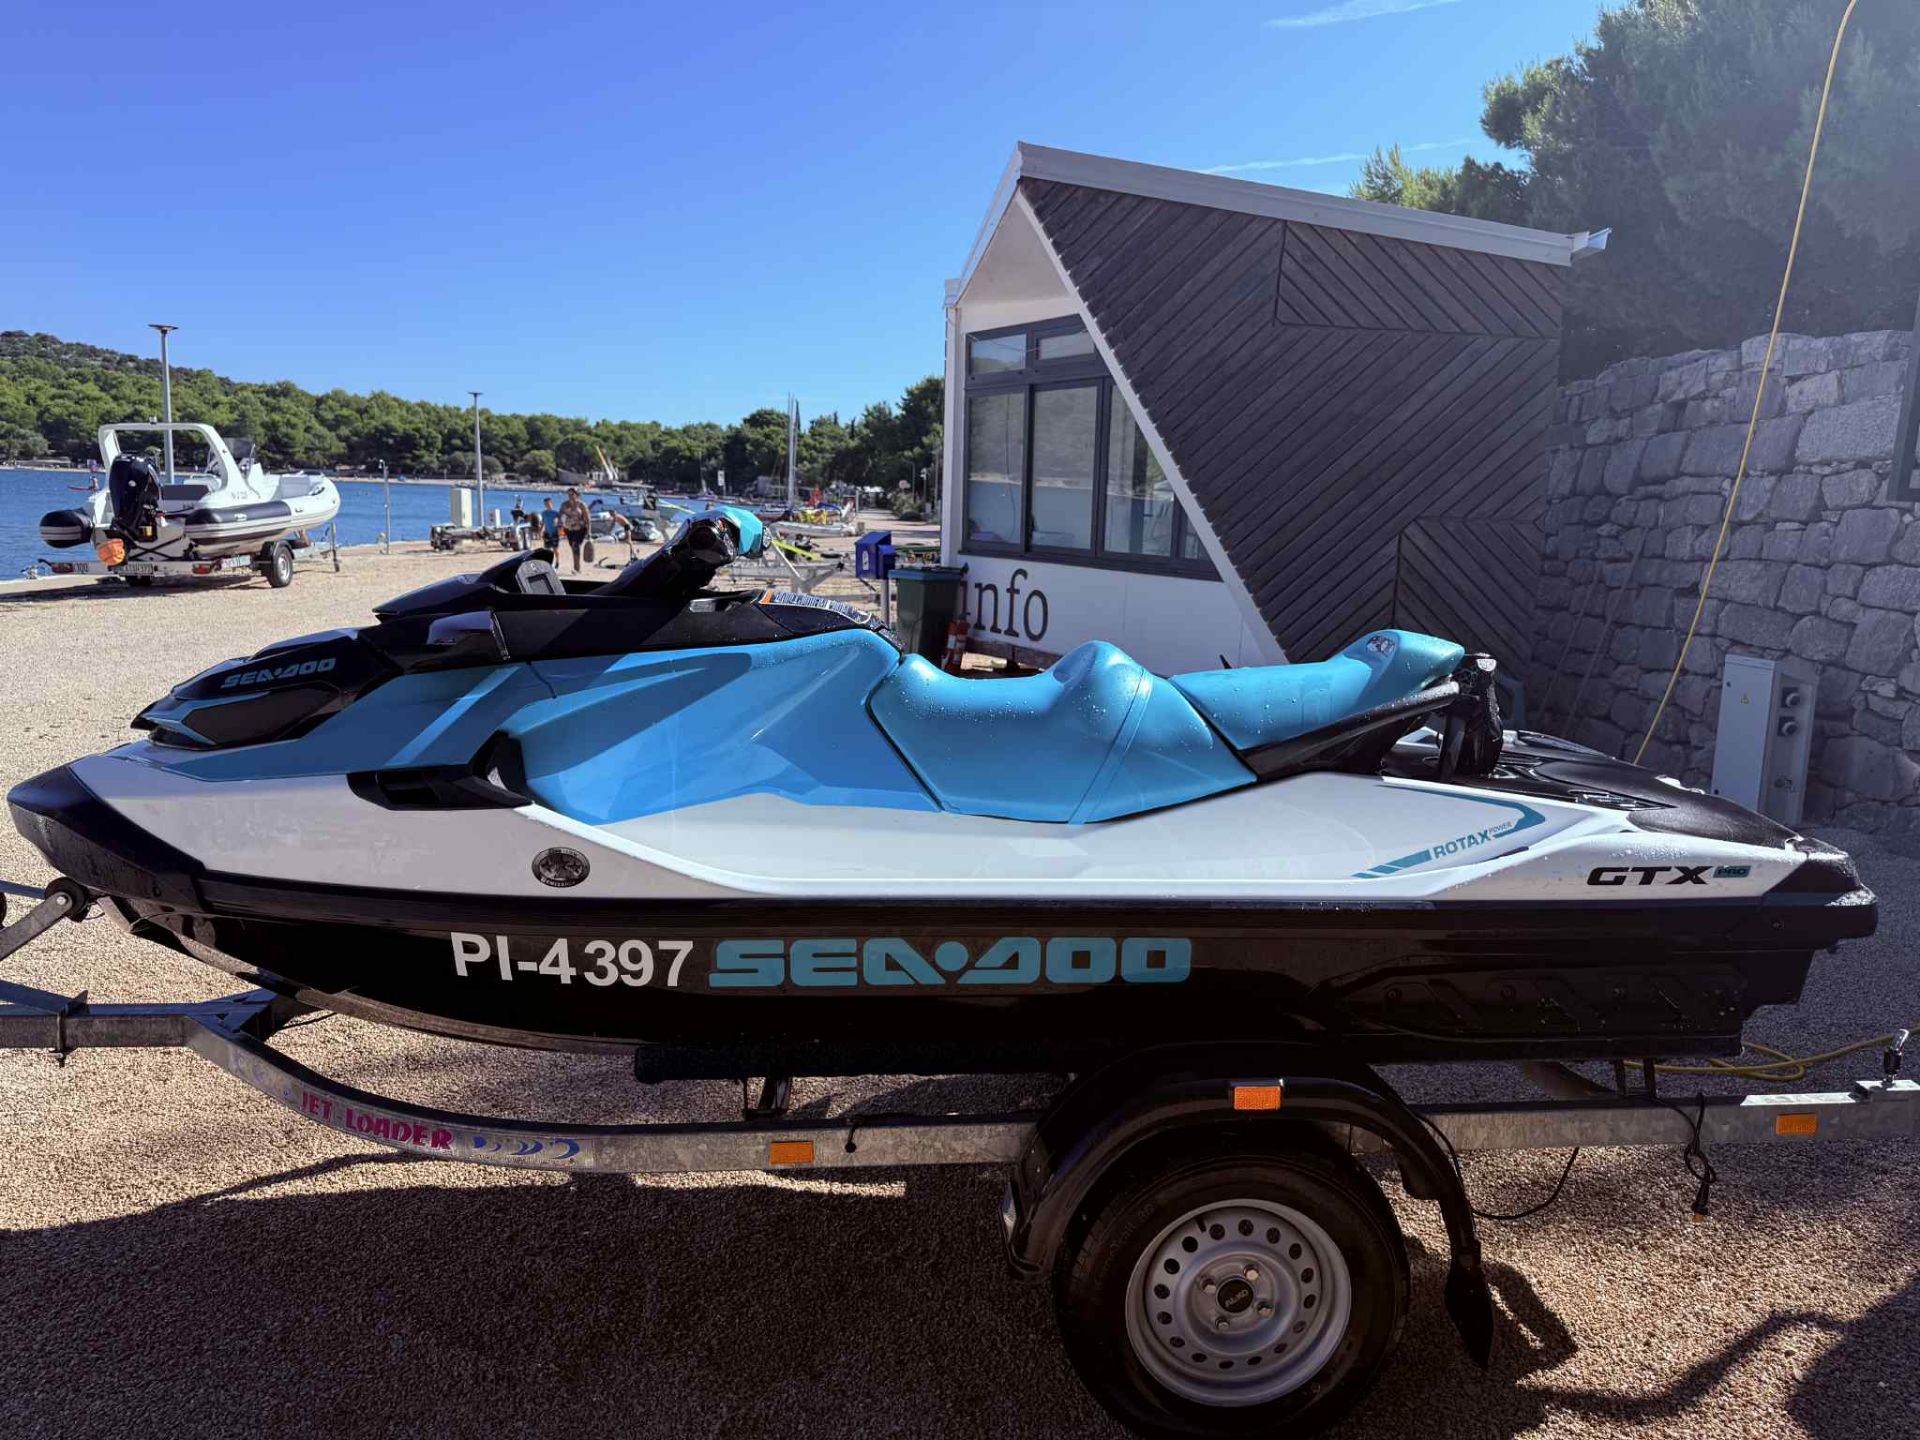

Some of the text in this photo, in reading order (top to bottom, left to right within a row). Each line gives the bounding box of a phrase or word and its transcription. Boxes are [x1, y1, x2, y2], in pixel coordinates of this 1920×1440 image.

[958, 562, 1049, 642] info
[1433, 830, 1491, 859] ROTAX
[1587, 866, 1713, 886] GTX
[345, 1107, 454, 1150] LOADER
